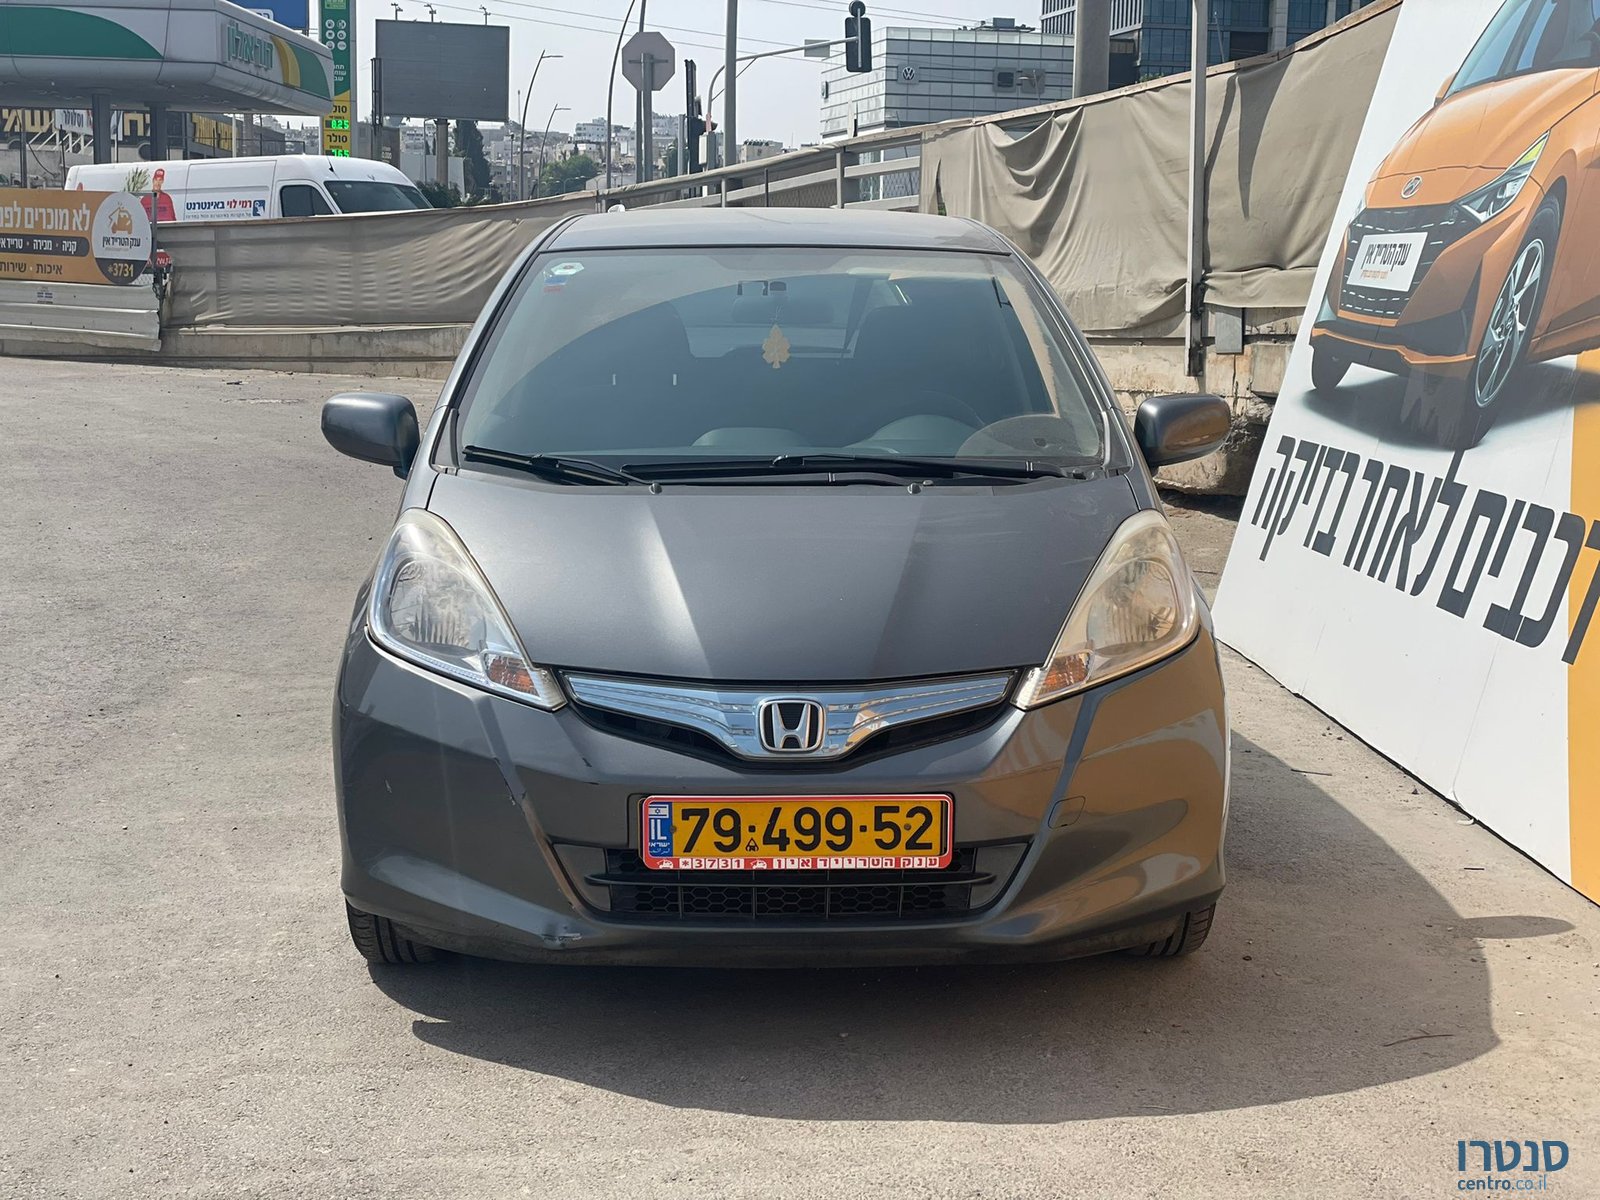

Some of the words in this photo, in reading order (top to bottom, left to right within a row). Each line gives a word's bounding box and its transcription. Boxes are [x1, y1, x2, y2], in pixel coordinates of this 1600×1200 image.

[332, 104, 347, 114] סול
[327, 133, 348, 143] סולר
[24, 207, 69, 231] מוכרים
[73, 202, 91, 231] לא
[62, 240, 77, 254] קניה
[36, 263, 63, 275] איכות
[1250, 434, 1361, 562] בדיקה
[1343, 450, 1468, 598] לאחר
[651, 819, 667, 840] IL
[775, 858, 811, 869] אין
[817, 858, 895, 869] הטרייד
[902, 858, 939, 869] ענק
